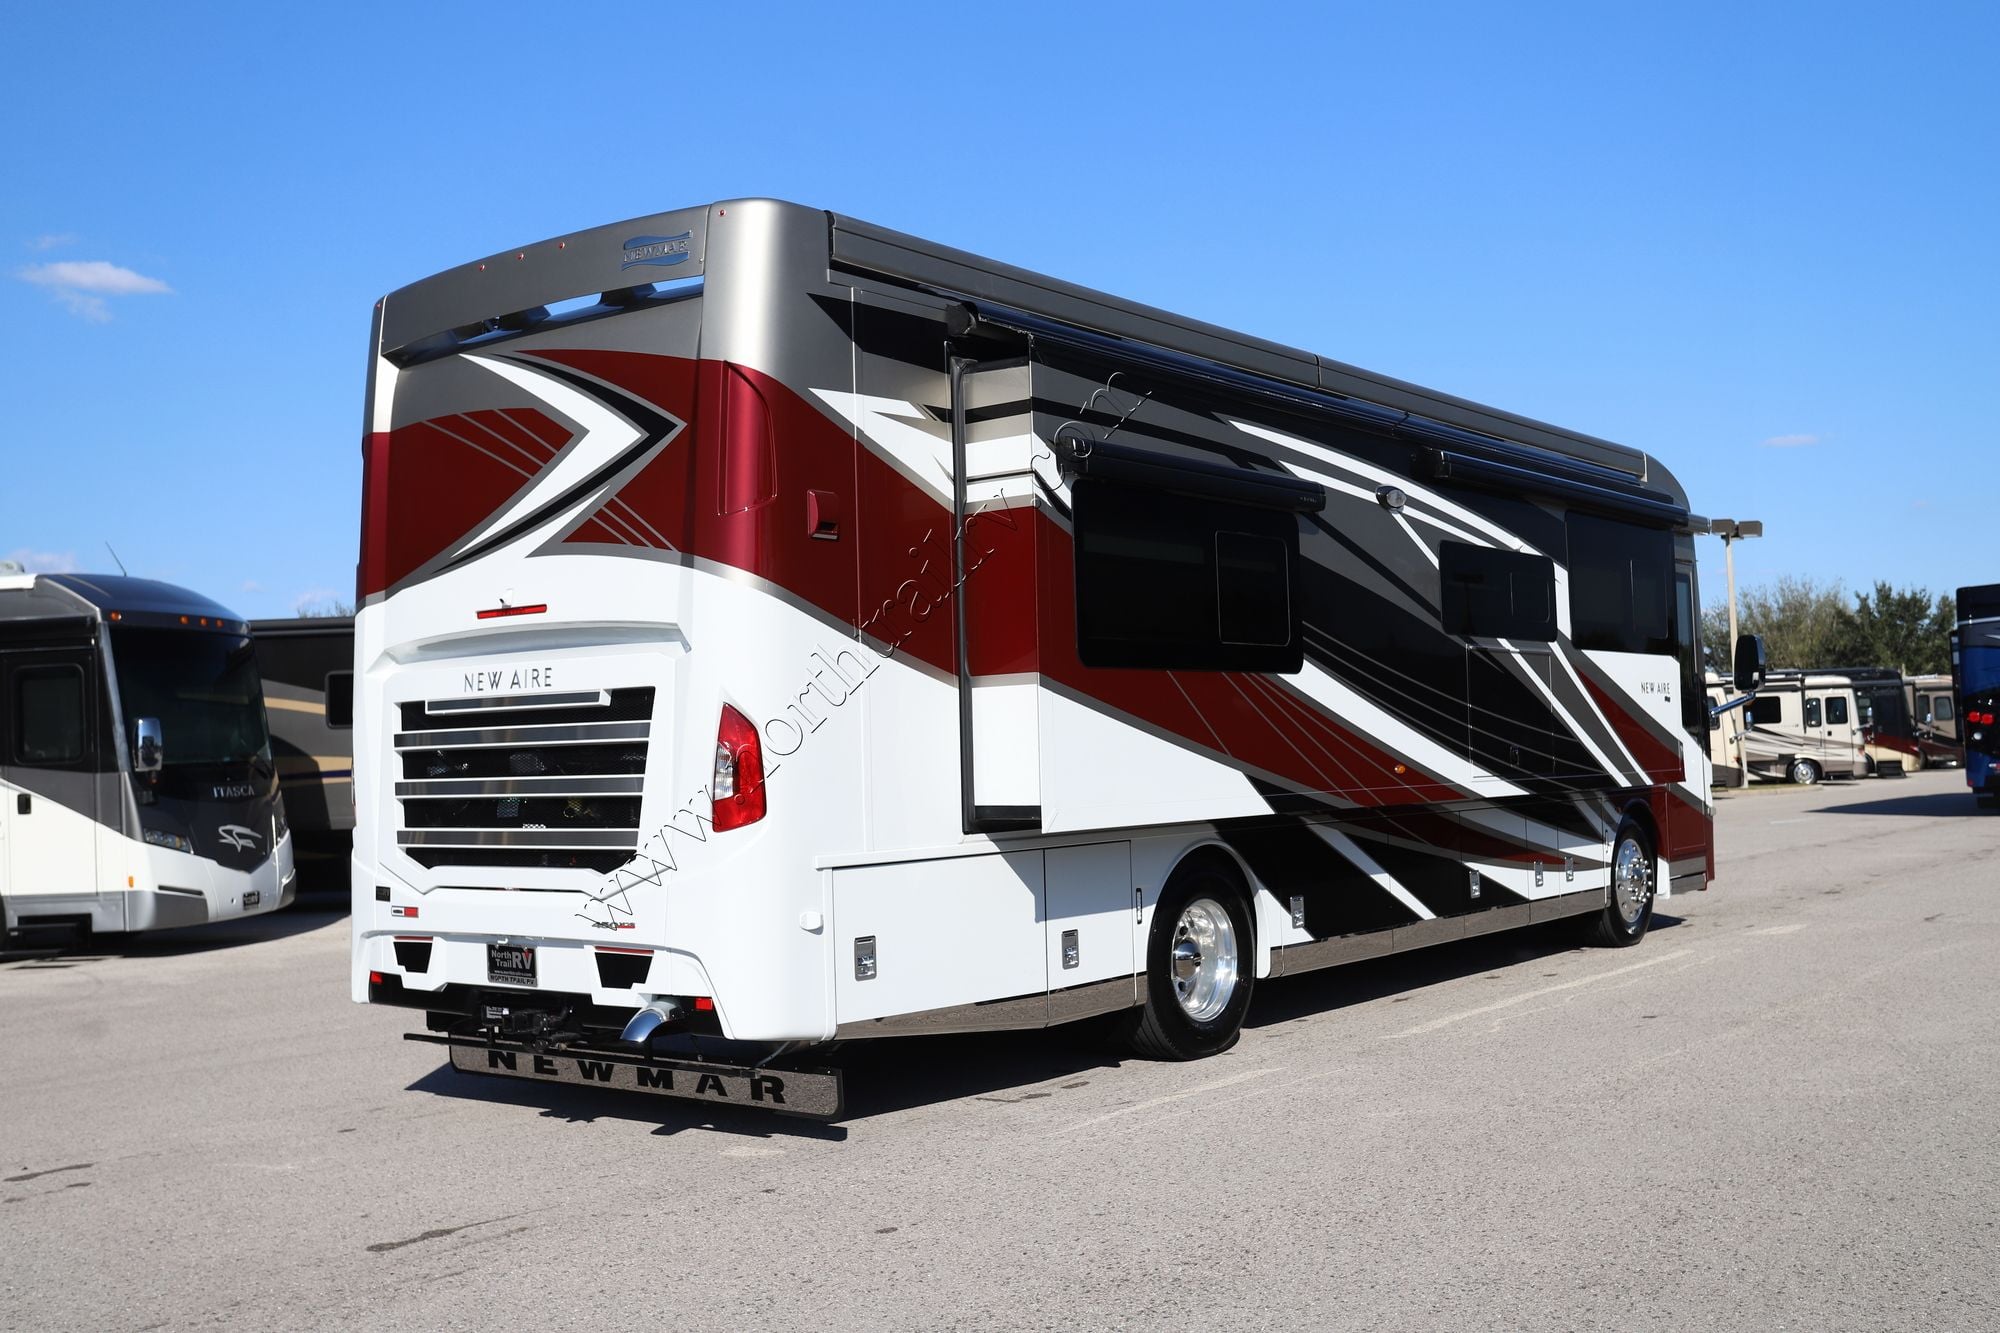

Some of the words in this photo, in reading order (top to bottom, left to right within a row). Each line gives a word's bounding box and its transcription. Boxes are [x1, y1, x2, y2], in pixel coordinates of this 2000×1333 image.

[623, 241, 689, 262] NEWMAR
[464, 671, 503, 692] NEW
[510, 667, 552, 689] AIRE
[1641, 681, 1654, 694] NEW
[1657, 682, 1670, 694] AIRE
[213, 784, 255, 798] ITASCA
[491, 950, 511, 959] North
[512, 951, 533, 970] RV
[495, 959, 512, 968] Trail
[488, 1050, 786, 1104] NEWMAR
